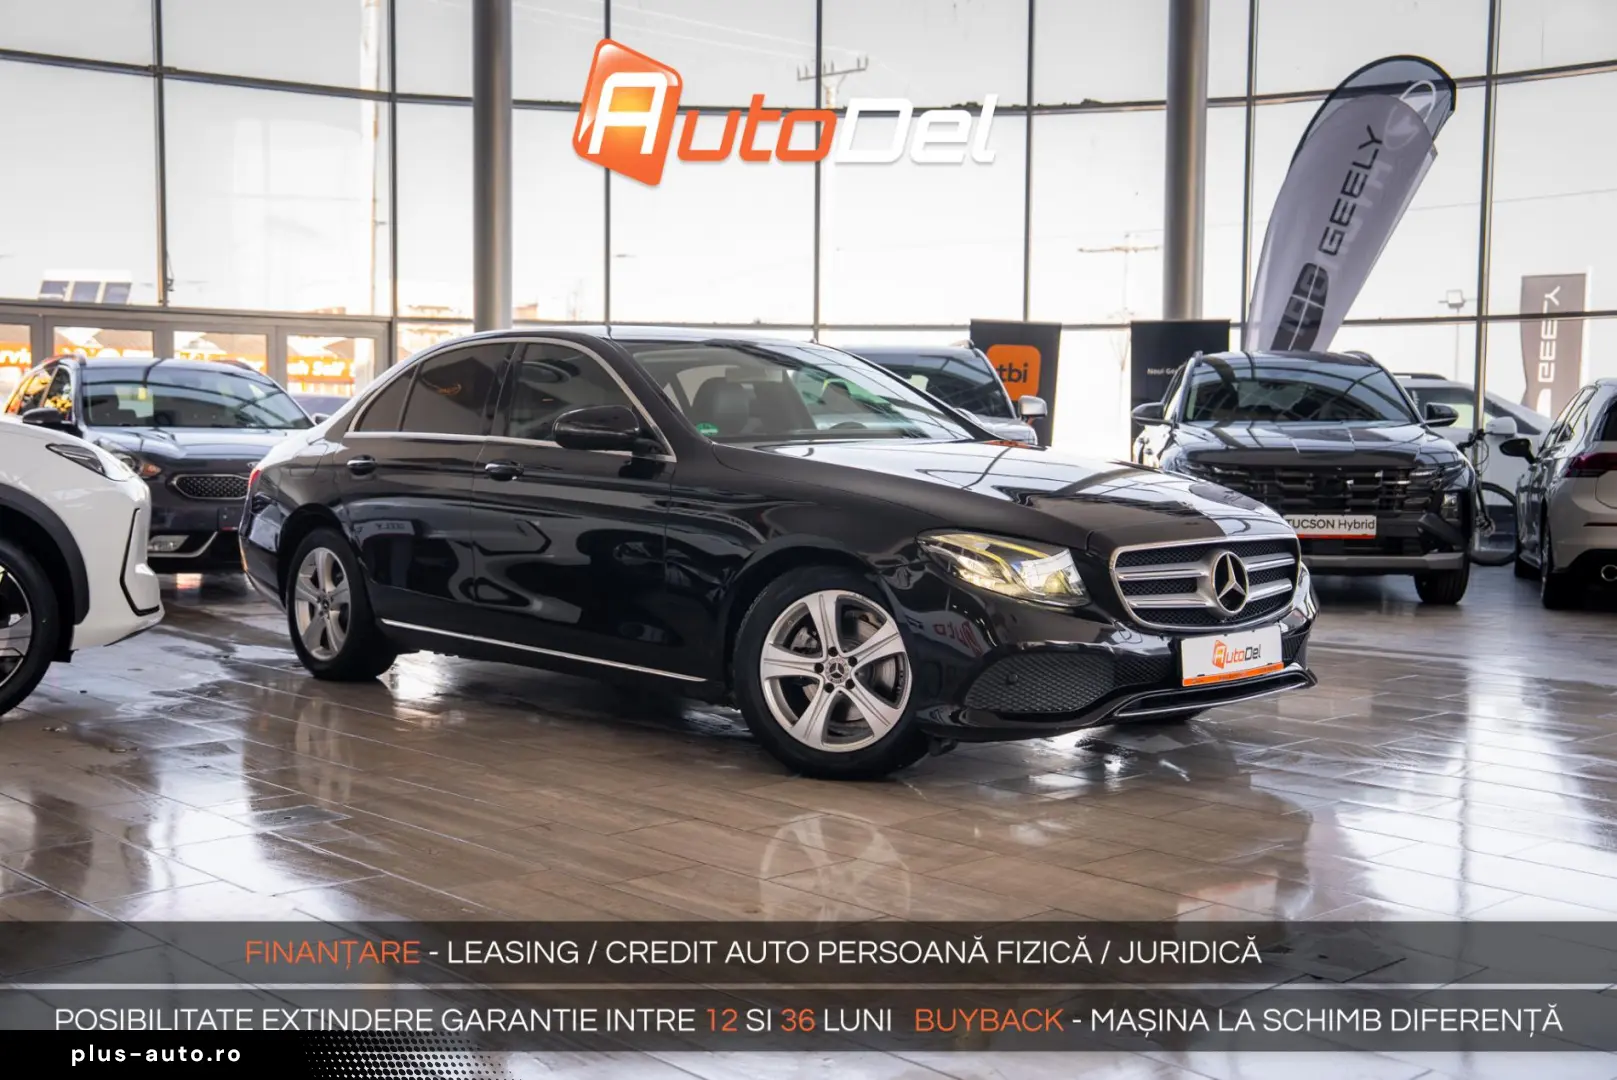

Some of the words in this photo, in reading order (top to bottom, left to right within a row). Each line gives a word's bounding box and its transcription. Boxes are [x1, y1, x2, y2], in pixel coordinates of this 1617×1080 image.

[1318, 124, 1383, 257] GEELY
[995, 362, 1029, 384] tbi
[1338, 518, 1375, 531] Hybrid
